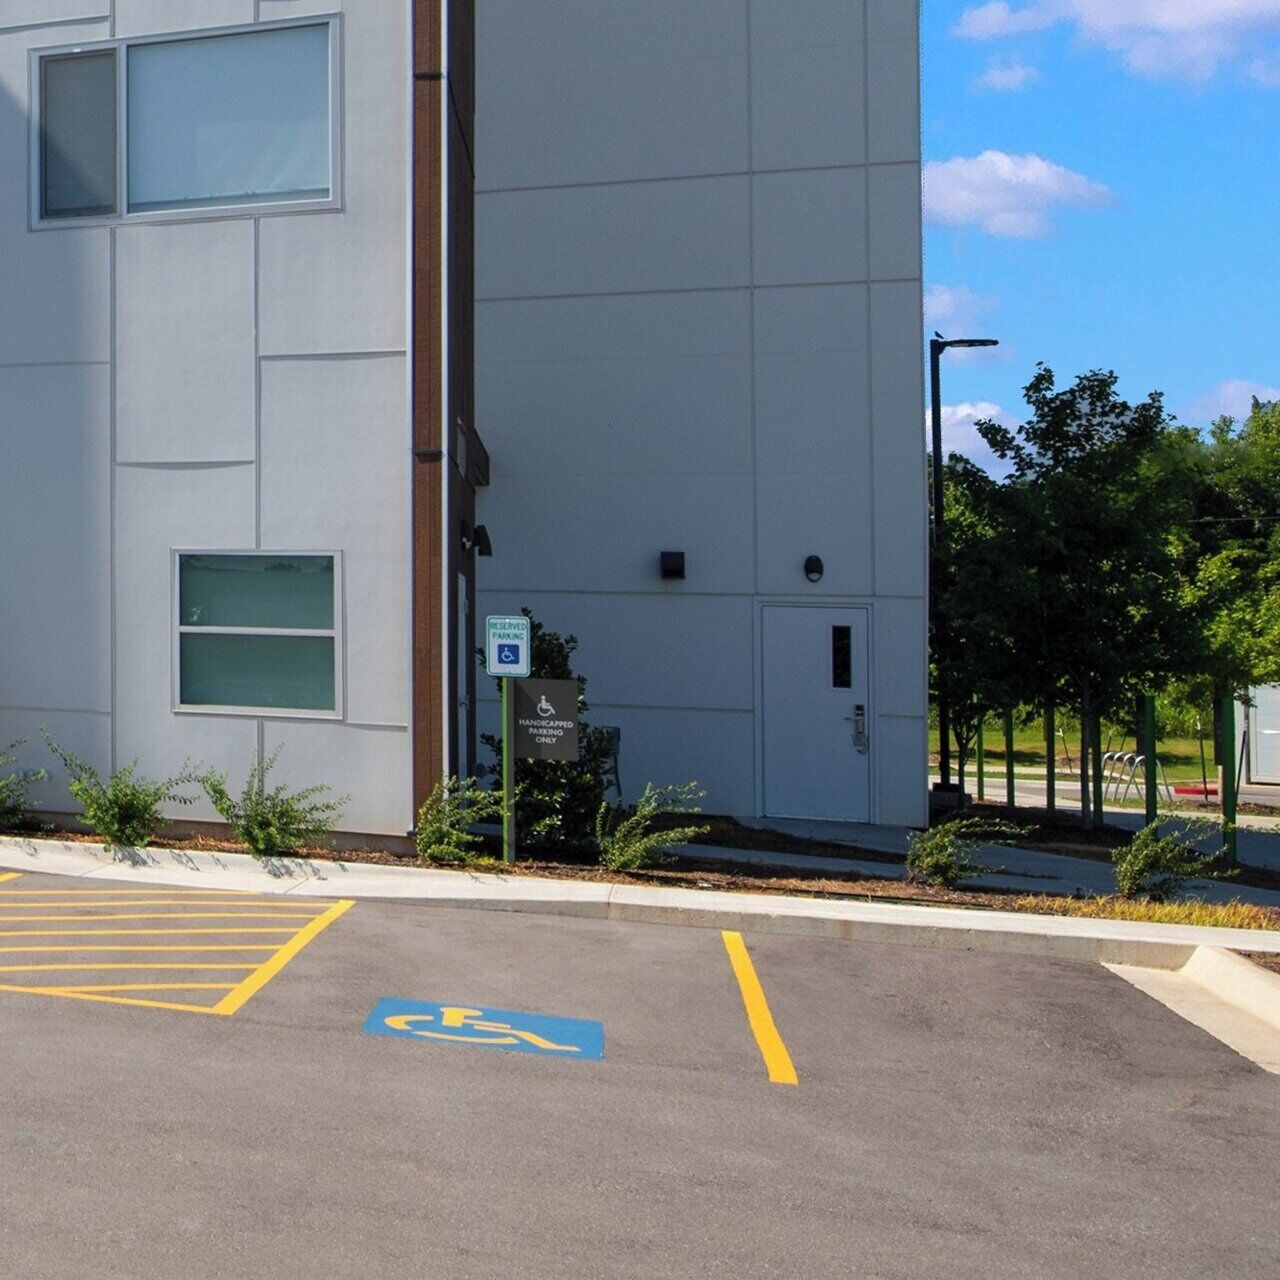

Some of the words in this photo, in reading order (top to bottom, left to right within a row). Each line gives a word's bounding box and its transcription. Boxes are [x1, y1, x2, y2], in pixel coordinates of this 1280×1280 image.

[490, 622, 527, 631] RESERVED
[492, 632, 525, 641] PARKING
[519, 718, 574, 729] HANDICAPPED
[528, 727, 564, 737] PARKING
[535, 736, 558, 744] ONLY
